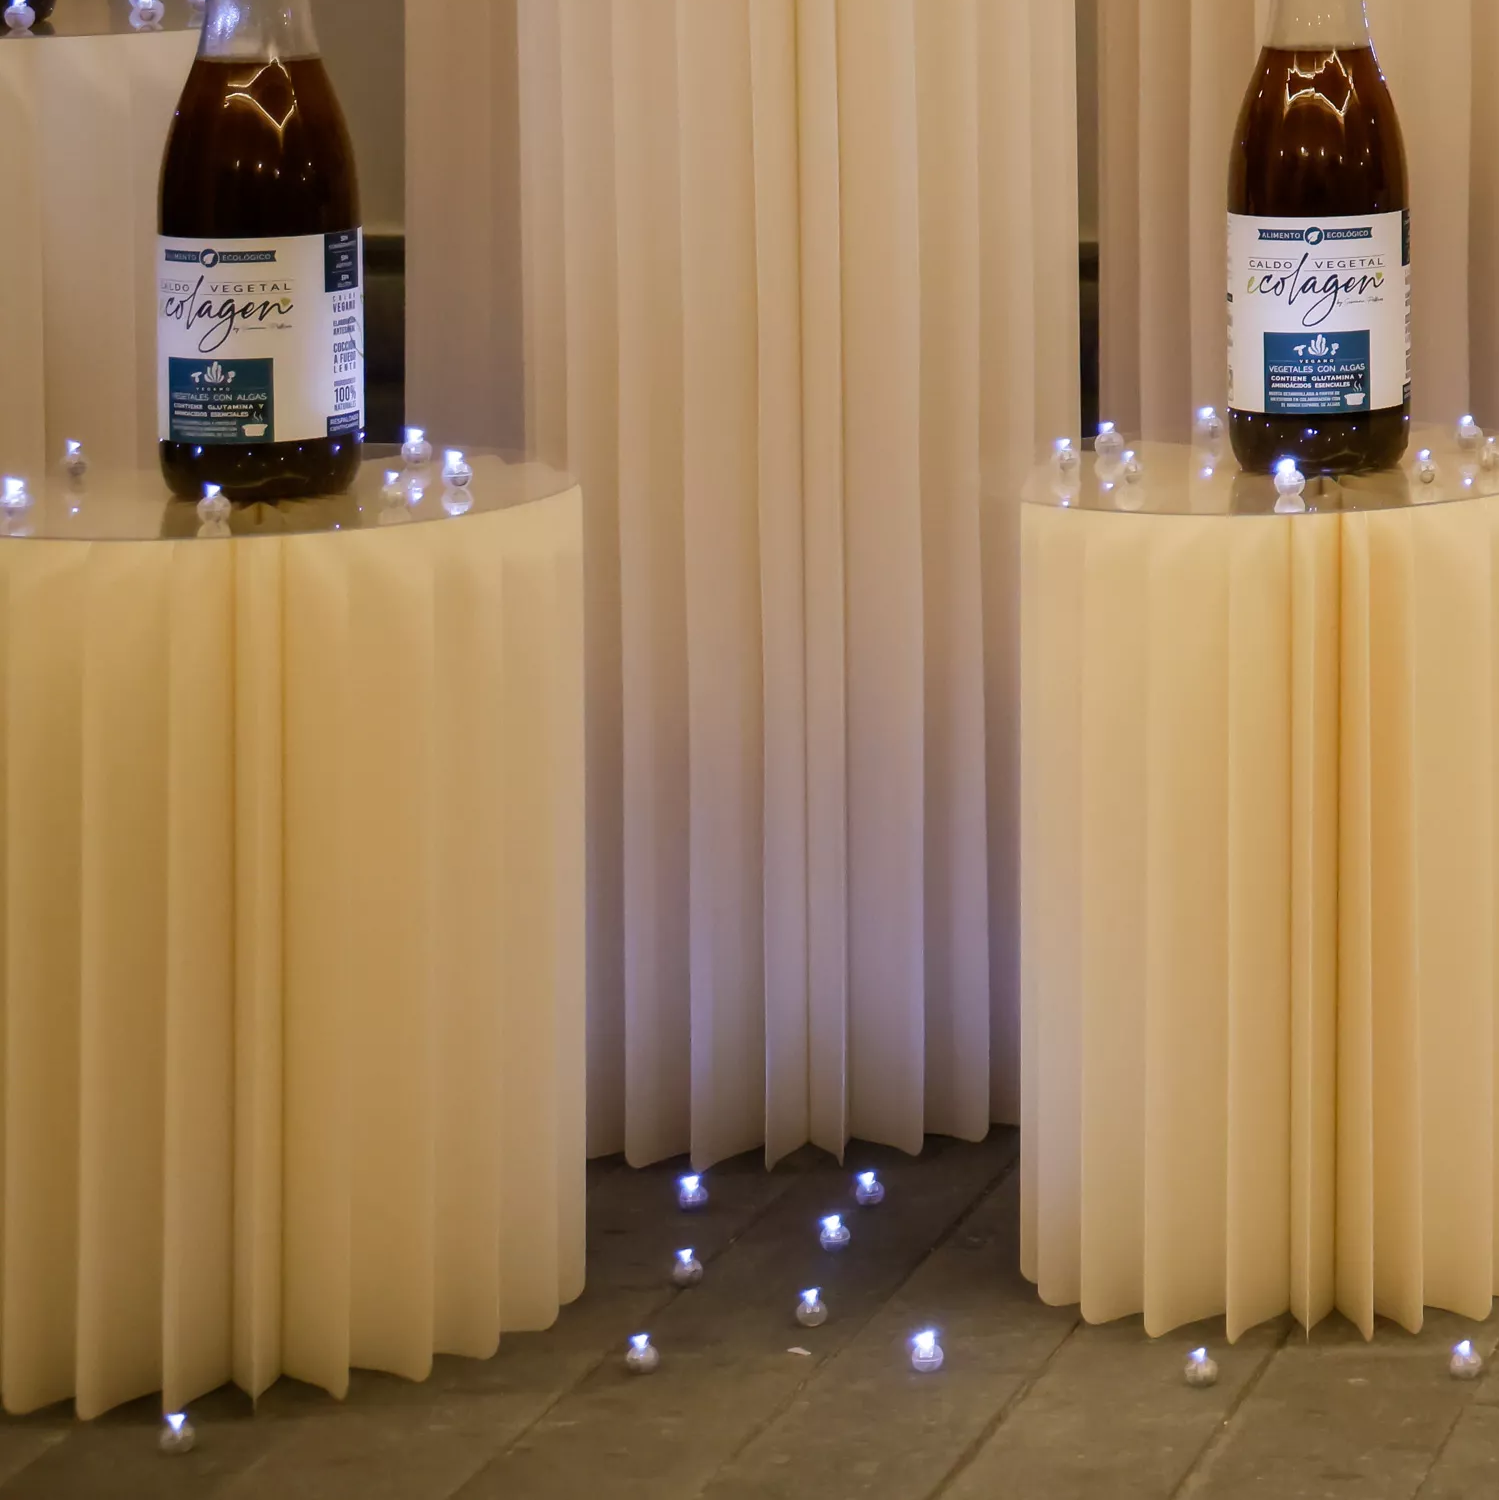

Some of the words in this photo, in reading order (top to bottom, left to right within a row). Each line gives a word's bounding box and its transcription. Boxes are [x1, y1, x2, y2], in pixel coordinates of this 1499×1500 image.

[1327, 230, 1368, 238] ECOLÓGICO
[223, 253, 271, 261] ECOLÓGICO
[1249, 260, 1292, 269] CALDO
[1315, 259, 1383, 269] VEGETAL
[210, 283, 291, 292] VEGETAL
[1269, 365, 1313, 373] VEGETALES
[237, 392, 267, 400] ALGAS
[334, 384, 356, 401] 100%
